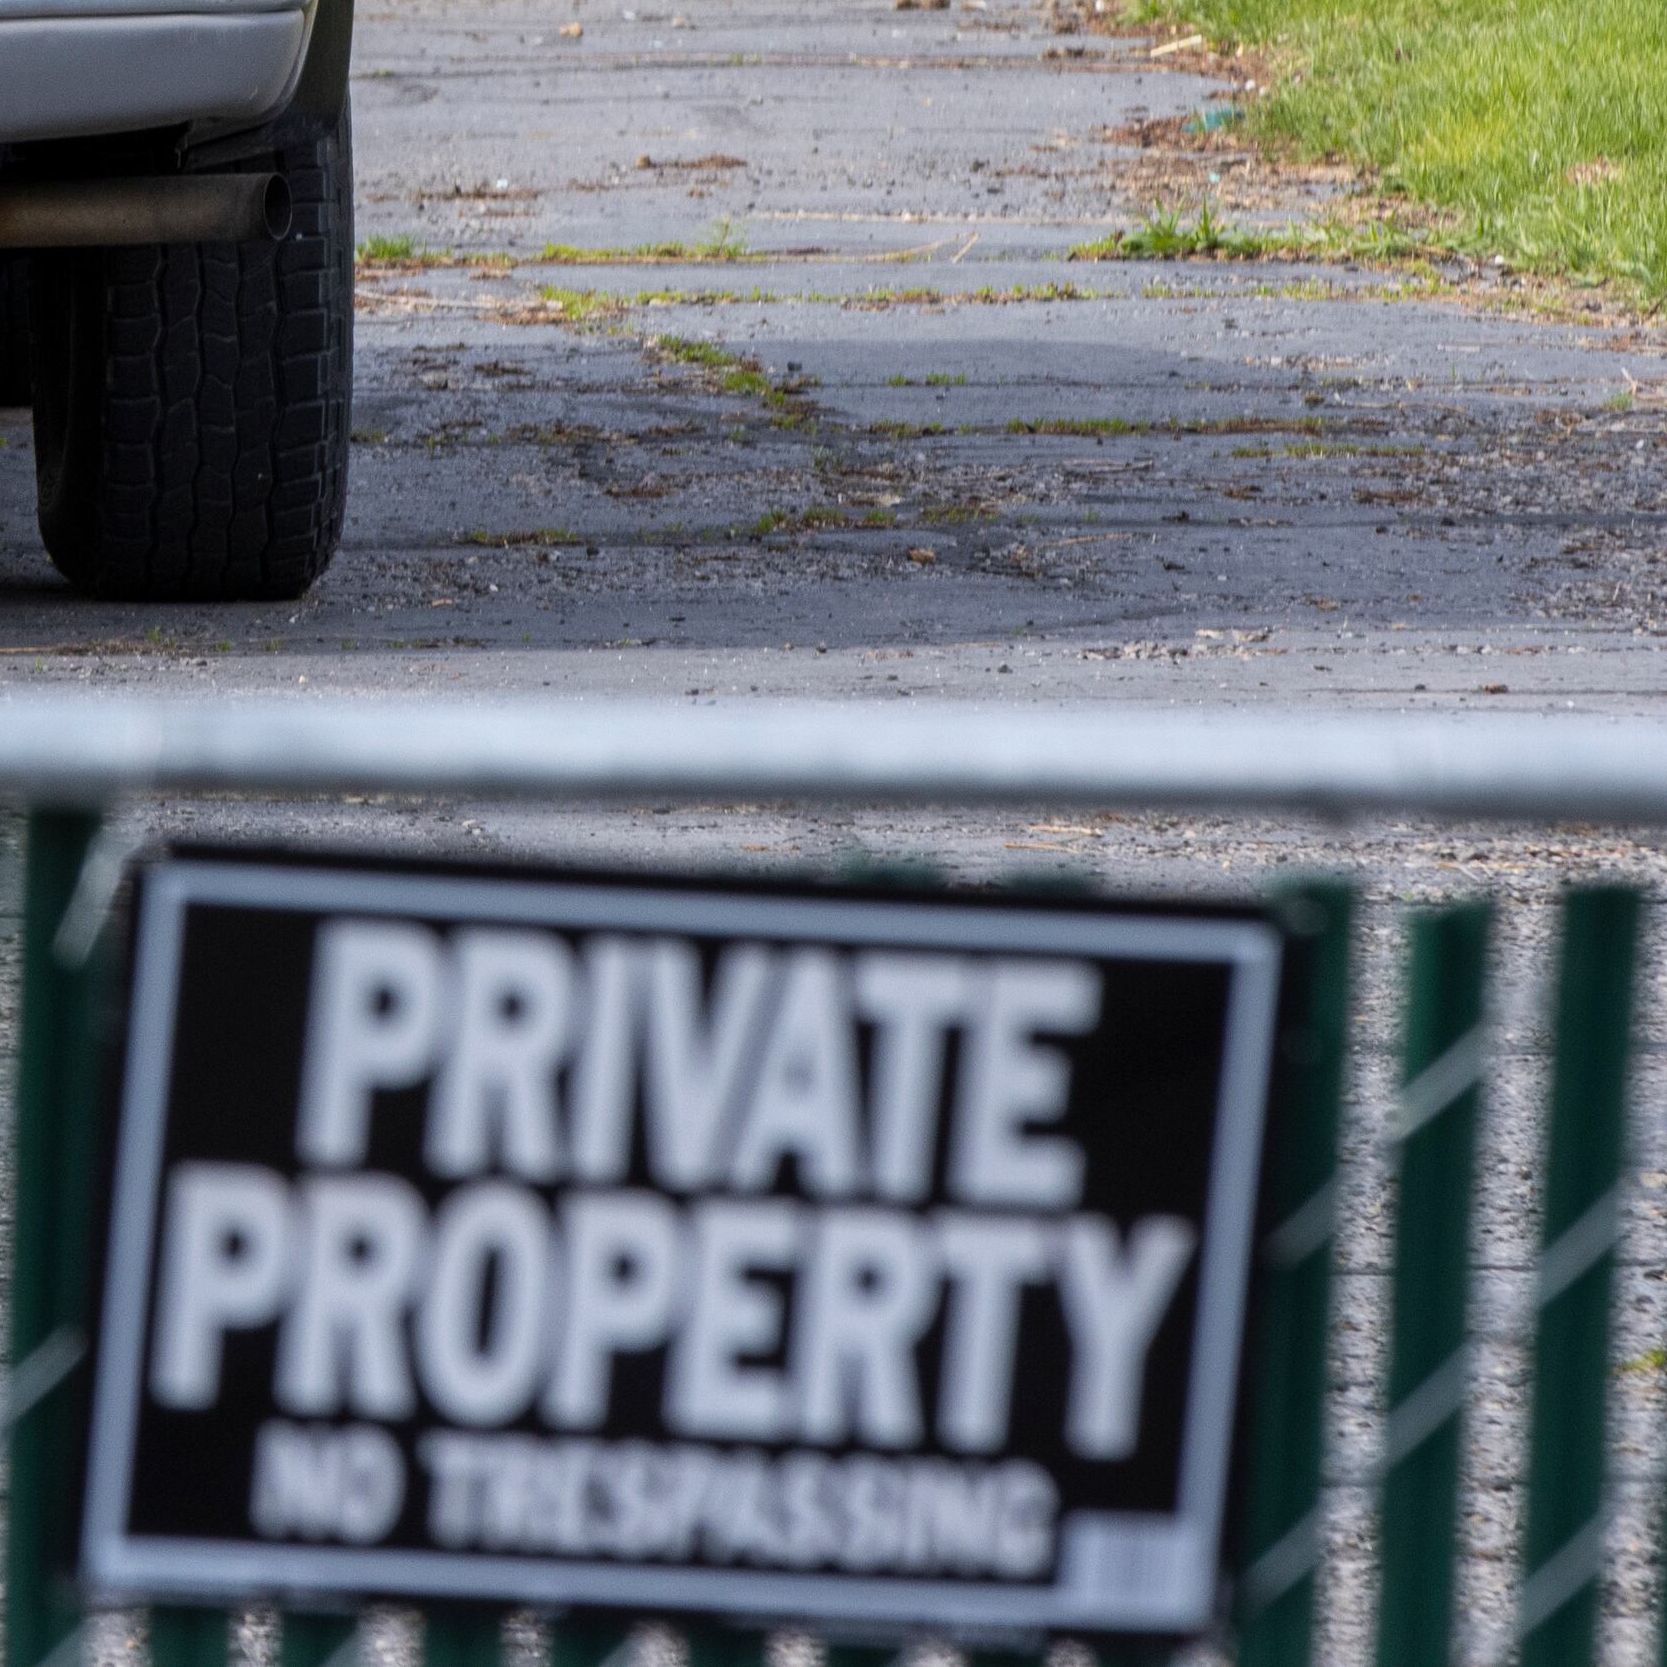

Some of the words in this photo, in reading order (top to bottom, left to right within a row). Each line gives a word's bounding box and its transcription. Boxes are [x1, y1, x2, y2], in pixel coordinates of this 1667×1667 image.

[295, 916, 1103, 1210] PRIVATE
[149, 1162, 1197, 1460] PROPERTY
[252, 1419, 409, 1540] NO
[422, 1429, 1061, 1580] TRESPASSING
